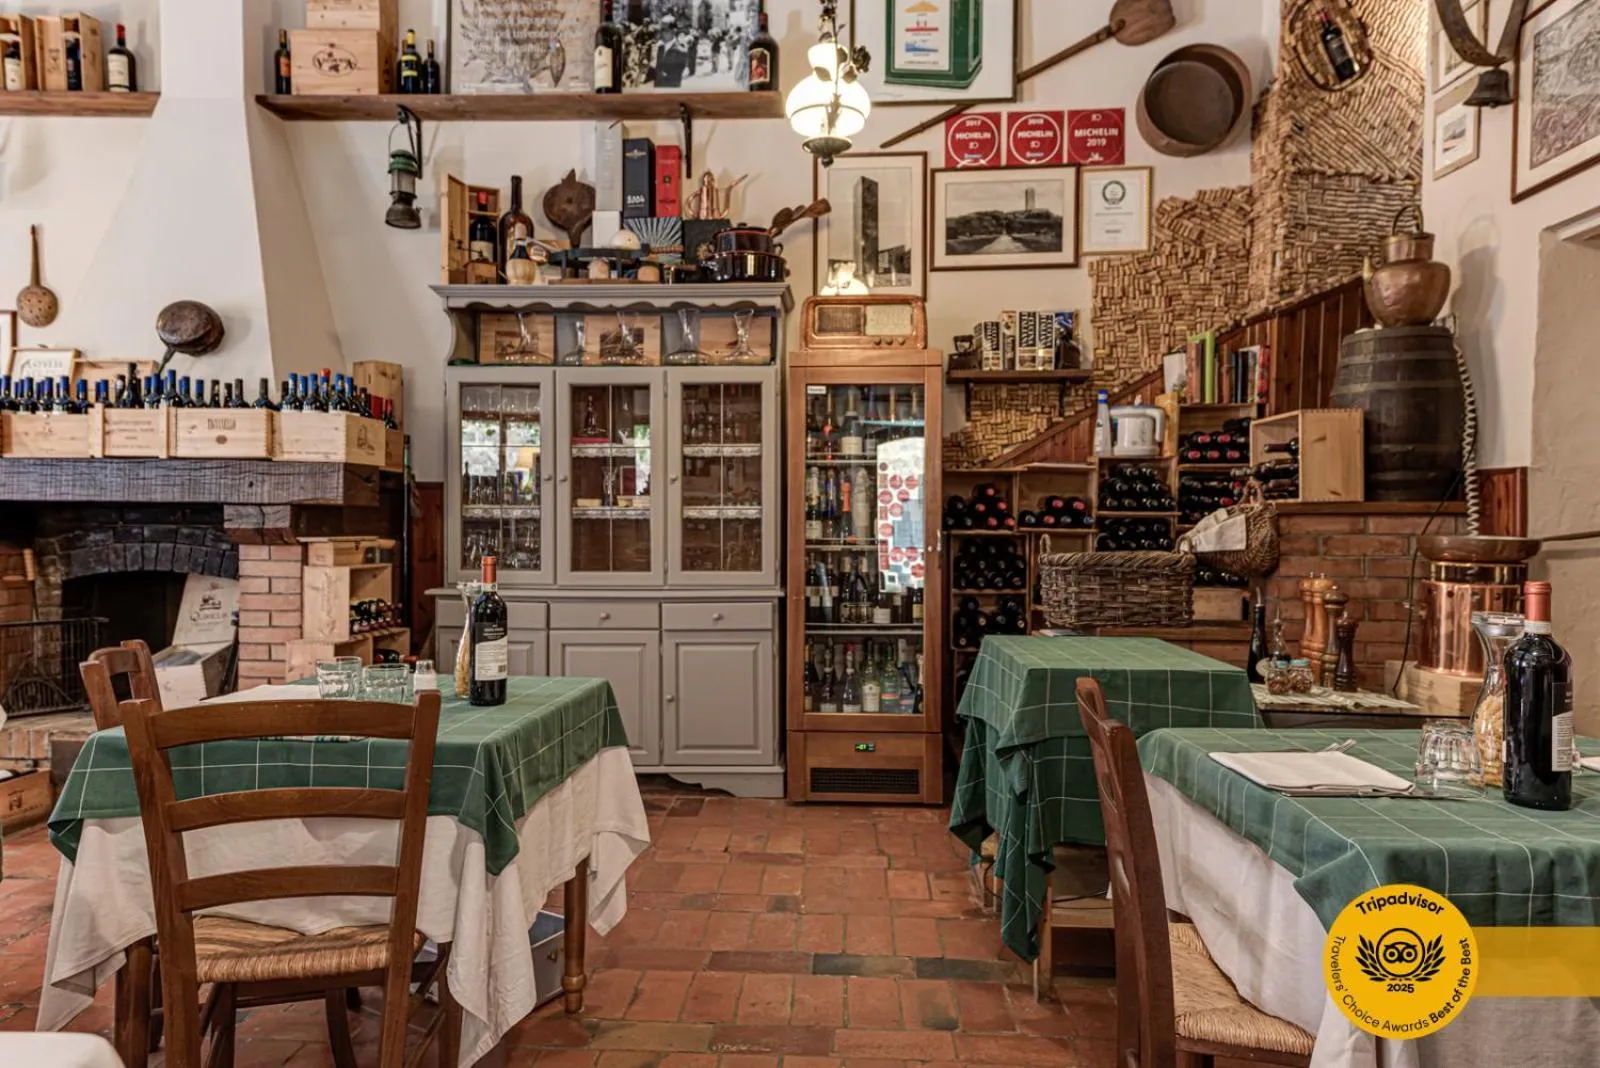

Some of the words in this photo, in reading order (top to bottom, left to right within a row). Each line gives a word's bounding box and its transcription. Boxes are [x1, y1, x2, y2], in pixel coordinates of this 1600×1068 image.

[955, 131, 992, 140] MICHELIN
[1017, 130, 1054, 139] MICHELIN
[1074, 128, 1118, 138] MICHELIN
[1086, 138, 1107, 147] 2019
